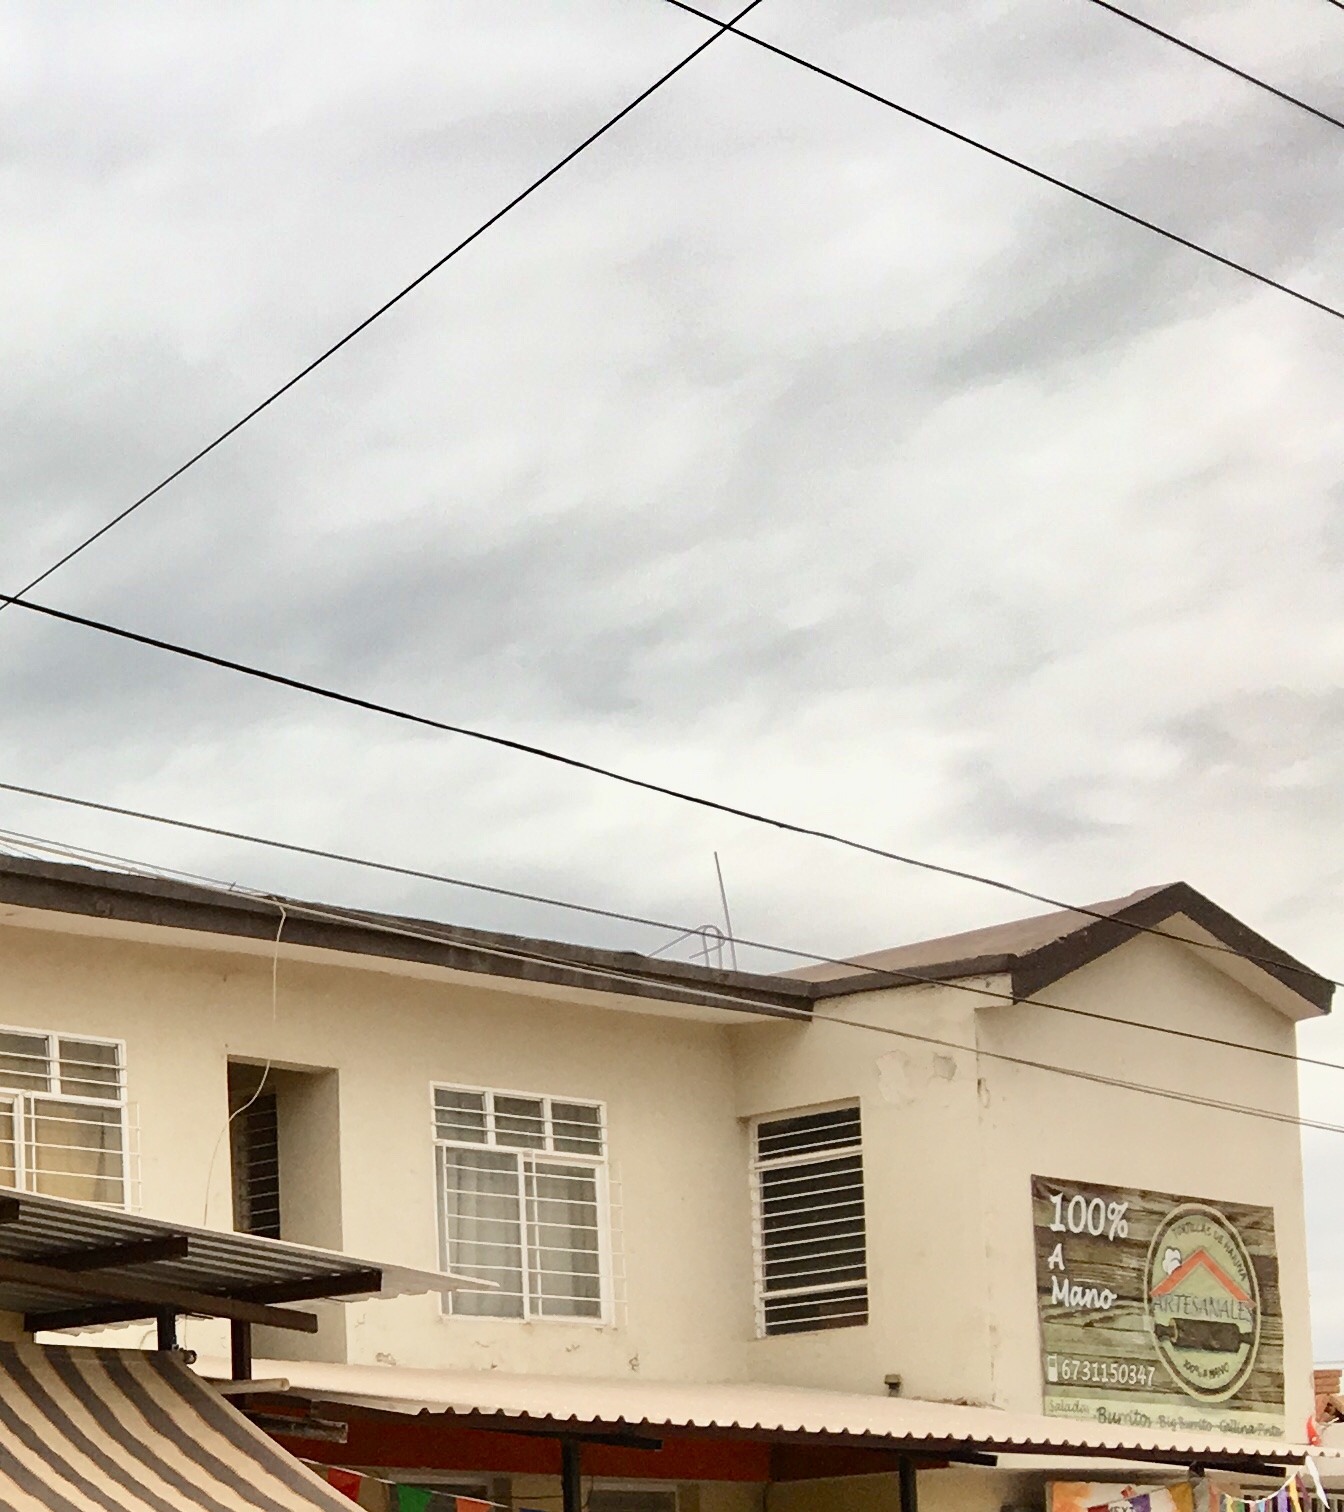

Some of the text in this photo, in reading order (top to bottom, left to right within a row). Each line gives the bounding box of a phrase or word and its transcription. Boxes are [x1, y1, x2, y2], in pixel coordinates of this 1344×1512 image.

[1049, 1192, 1129, 1242] 100%
[1047, 1242, 1066, 1271] A
[1051, 1275, 1118, 1310] Mano
[1062, 1359, 1156, 1387] 6731150347
